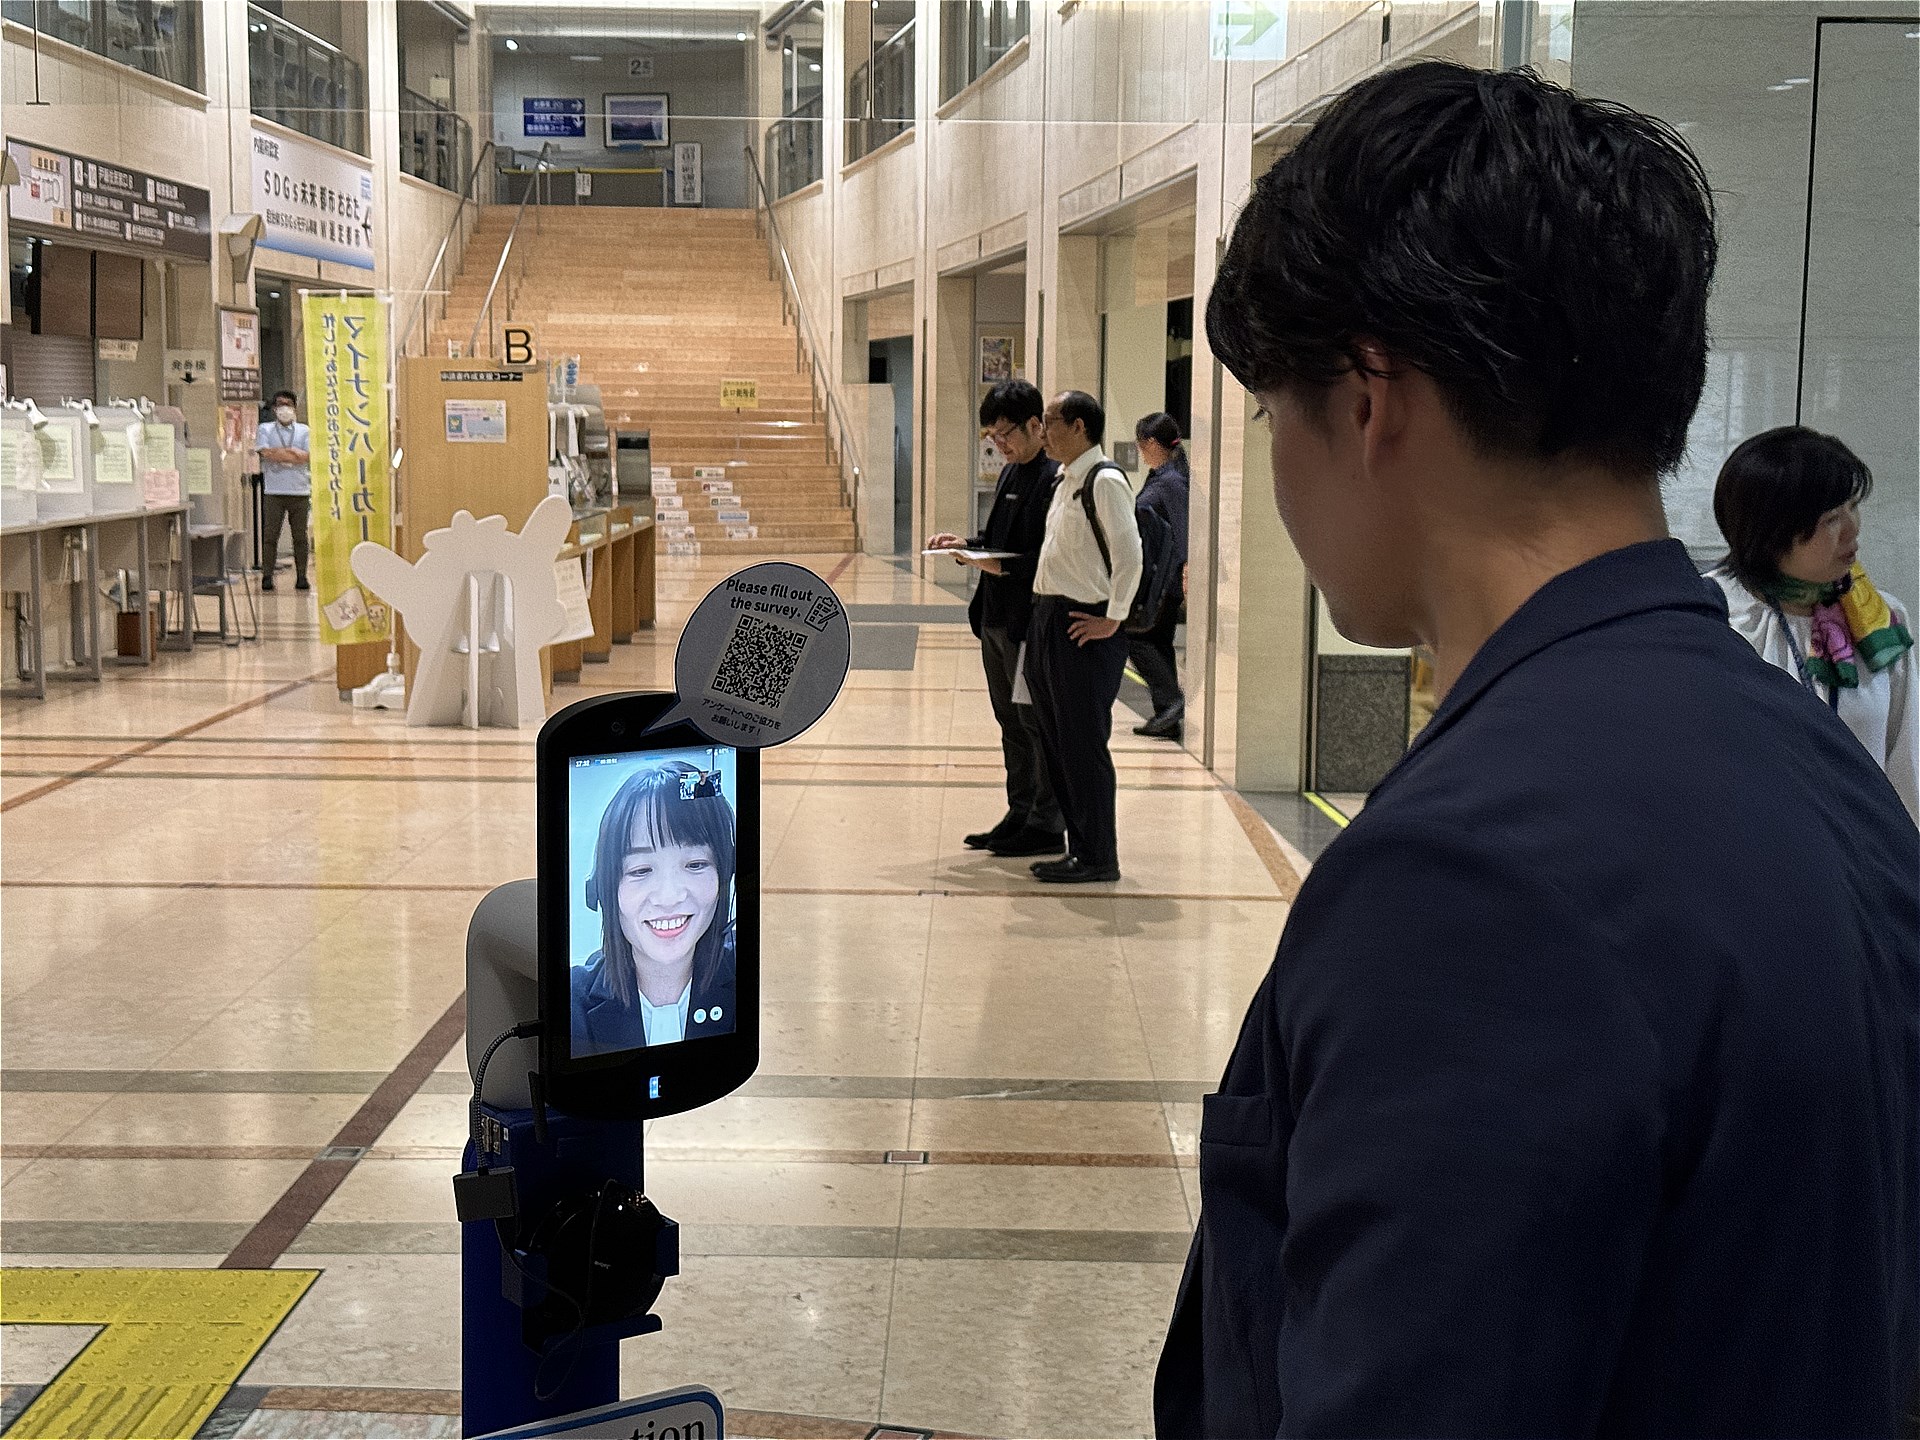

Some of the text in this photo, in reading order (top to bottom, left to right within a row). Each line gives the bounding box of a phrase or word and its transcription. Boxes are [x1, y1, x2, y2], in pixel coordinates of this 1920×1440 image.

[264, 170, 360, 221] SDGs未来都市おおた
[505, 328, 534, 364] B
[726, 578, 813, 602] Please fill out
[731, 596, 801, 620] the survey.
[702, 698, 782, 730] アンケートへのご協力を
